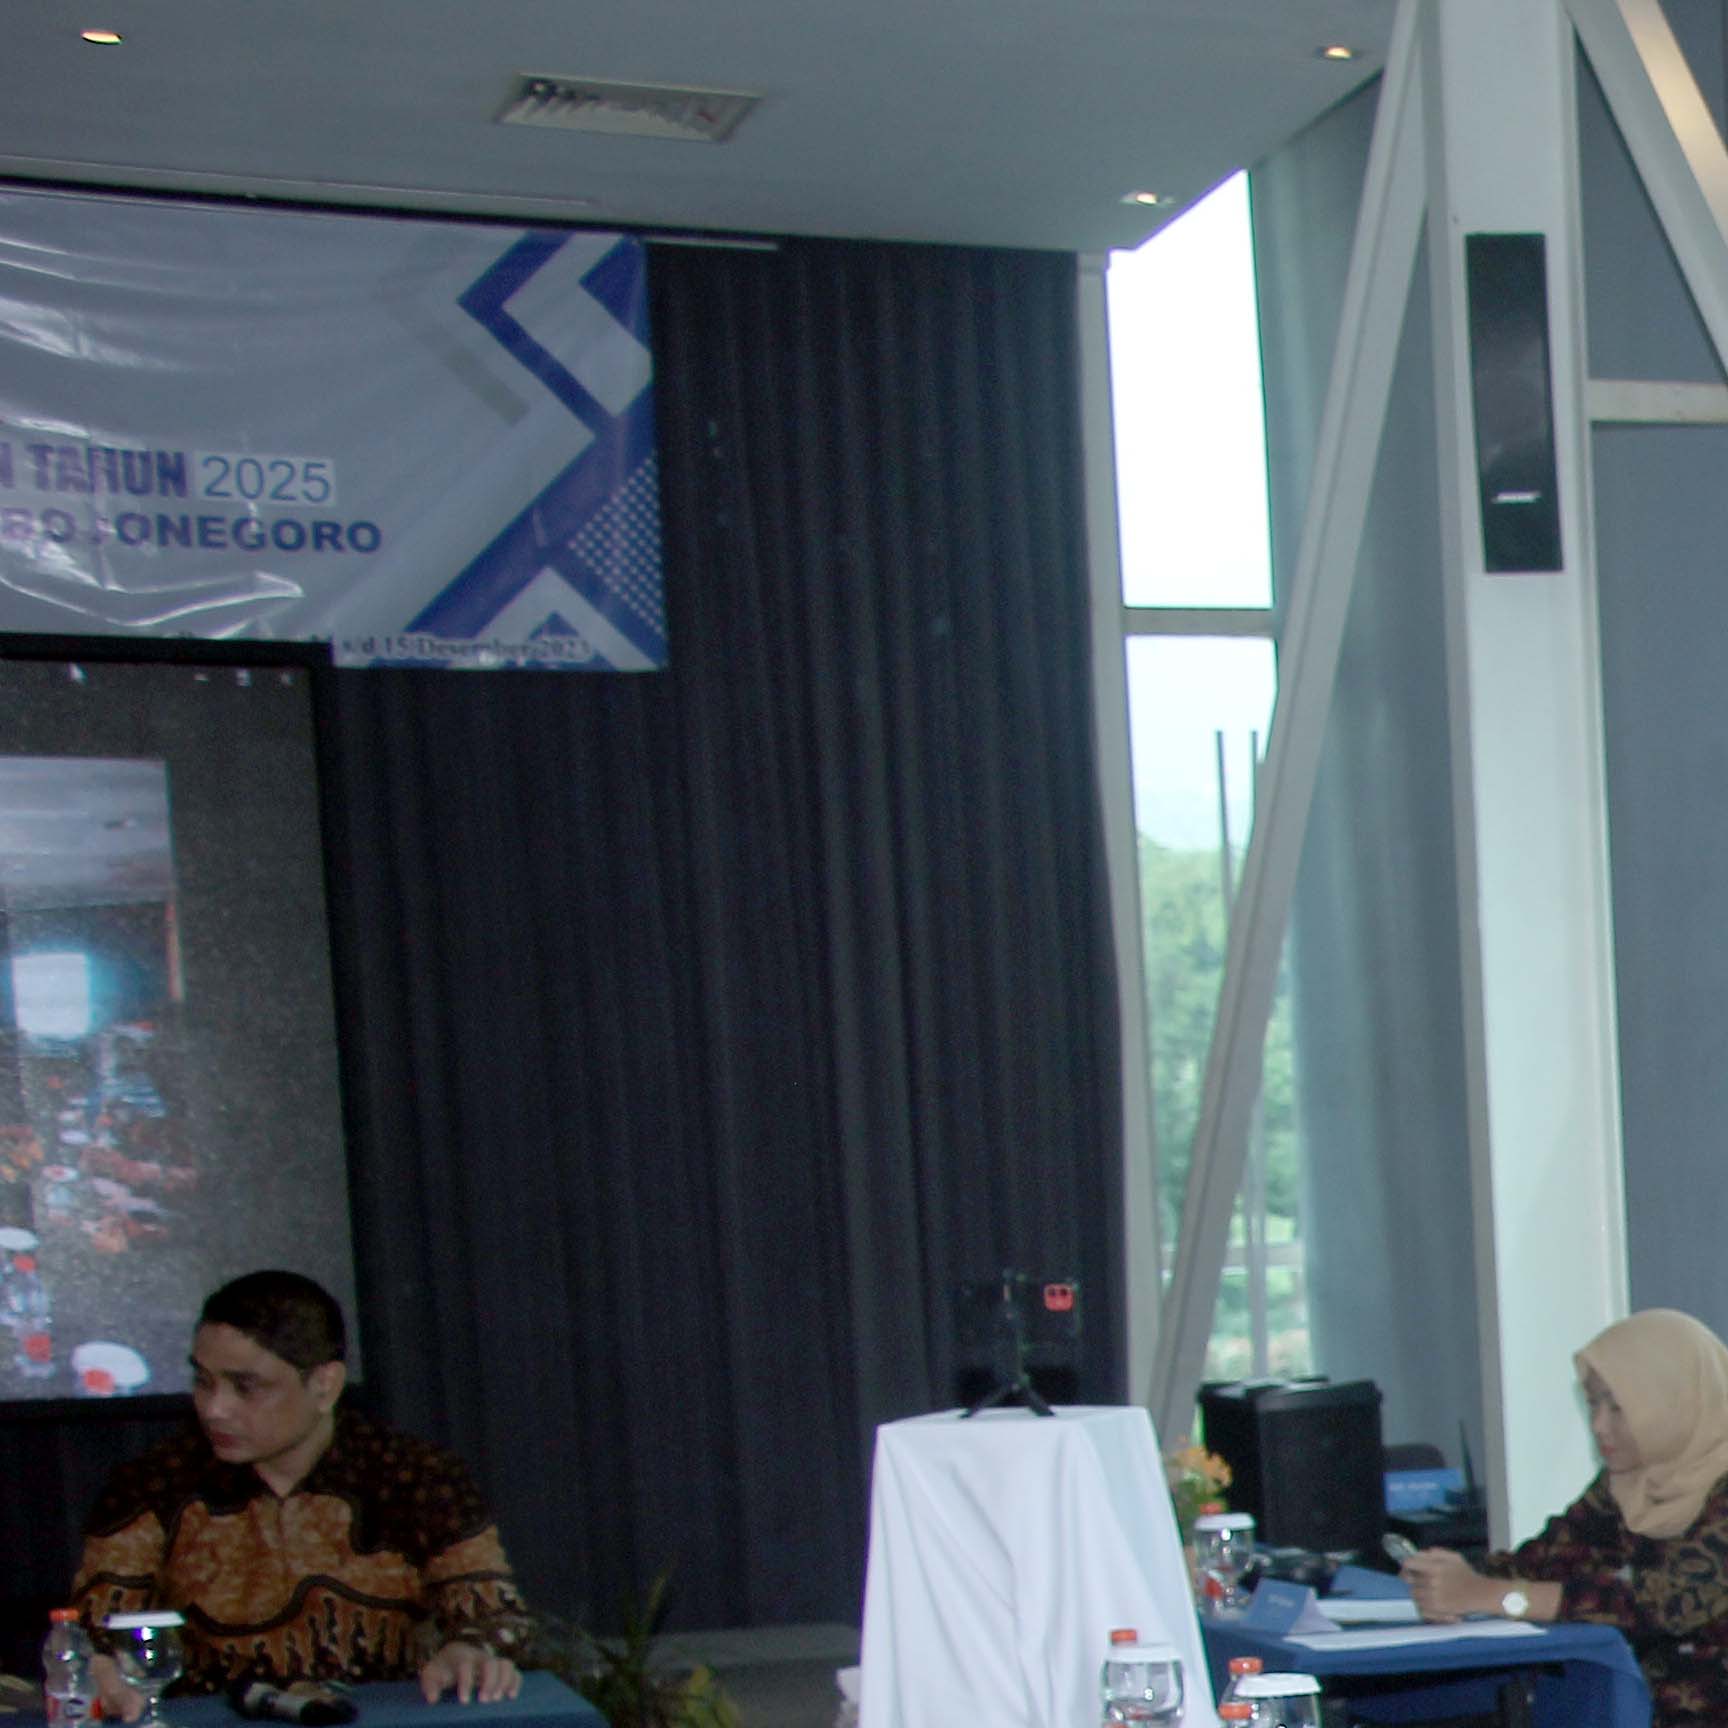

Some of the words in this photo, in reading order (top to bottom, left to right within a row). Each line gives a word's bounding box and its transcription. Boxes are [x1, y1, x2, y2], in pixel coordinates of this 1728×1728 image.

[27, 444, 188, 497] TAHUN
[202, 455, 331, 502] 2025
[1, 507, 382, 552] BOONEGORO
